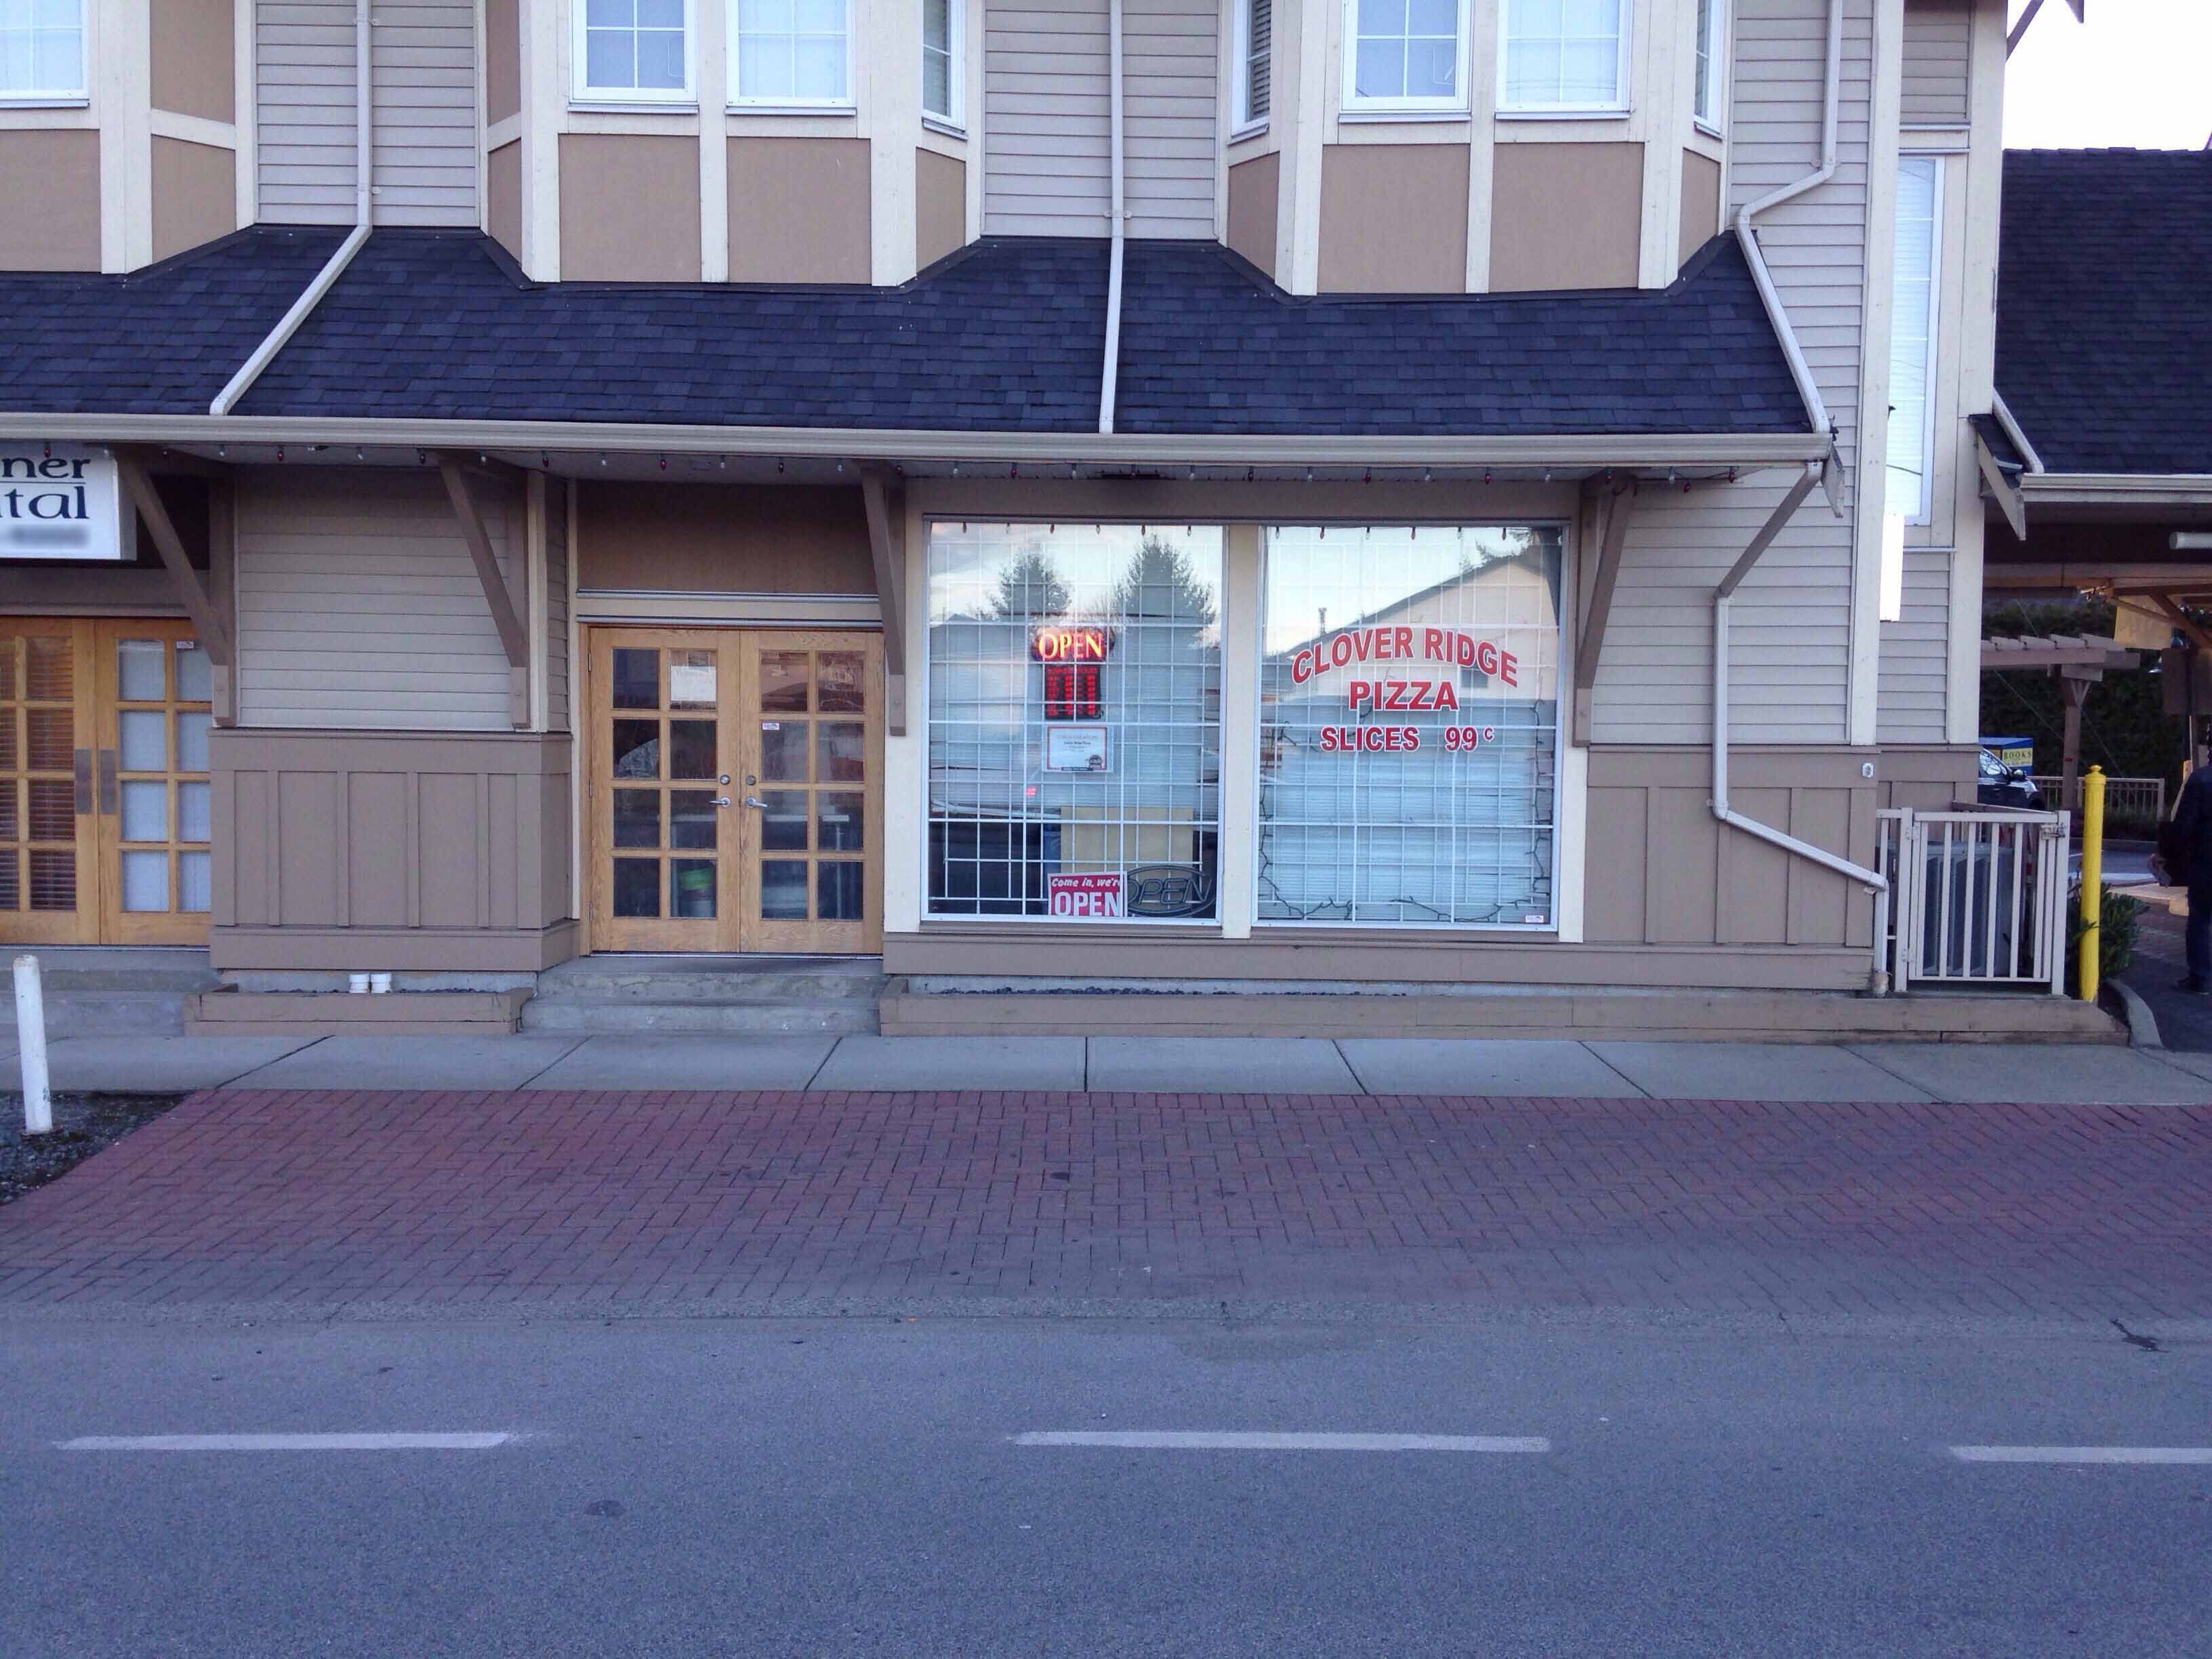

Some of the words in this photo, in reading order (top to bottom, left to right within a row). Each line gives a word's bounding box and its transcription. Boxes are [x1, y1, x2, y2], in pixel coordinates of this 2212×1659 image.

[1, 457, 91, 478] ner
[0, 486, 89, 519] tal
[1038, 634, 1103, 658] OPEN
[1292, 627, 1414, 683] CLOVER
[1424, 627, 1518, 688] RIDGE
[1349, 680, 1459, 710] PIZZA
[1320, 726, 1420, 752] SLICES
[2004, 751, 2031, 760] BOOKS
[1052, 878, 1079, 887] Come
[1082, 878, 1094, 888] in,
[1055, 892, 1120, 916] OPEN
